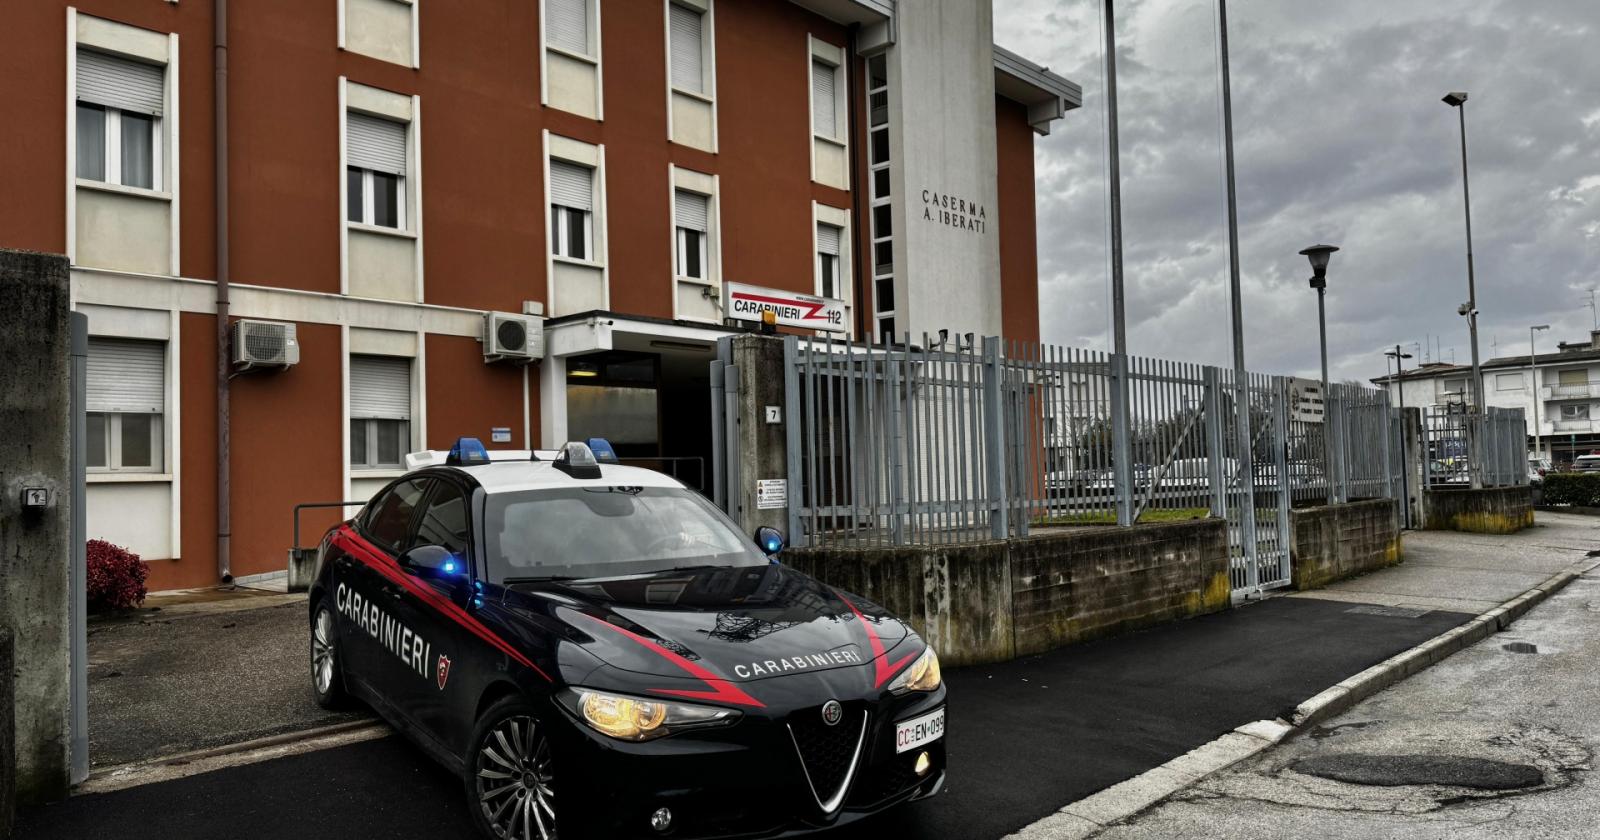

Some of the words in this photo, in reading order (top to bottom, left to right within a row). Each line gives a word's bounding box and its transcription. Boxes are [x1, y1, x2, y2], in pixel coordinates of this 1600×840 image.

[922, 189, 986, 219] CASERMA
[923, 207, 935, 222] A.
[939, 209, 985, 234] IBERATI
[827, 309, 842, 325] 112
[771, 410, 777, 420] 7
[336, 582, 431, 680] CARABINIERI
[734, 650, 862, 678] CARABINIERI
